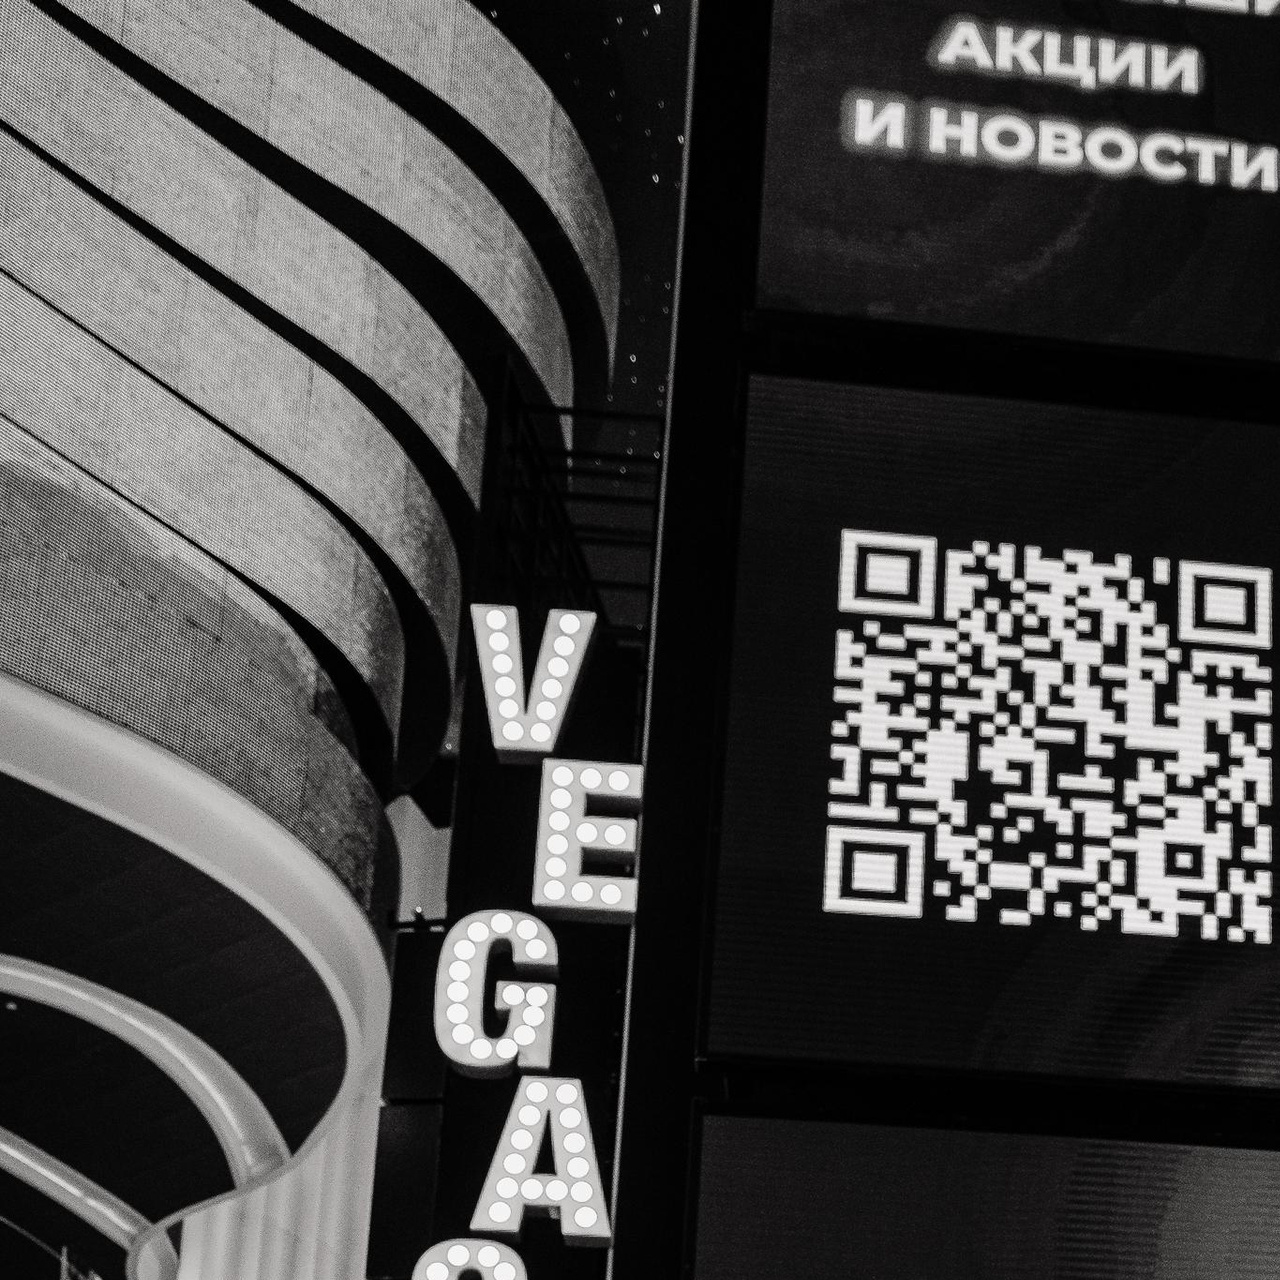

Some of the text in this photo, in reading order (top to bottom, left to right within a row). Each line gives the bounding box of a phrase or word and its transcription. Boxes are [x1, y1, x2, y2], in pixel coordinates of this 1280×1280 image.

[938, 21, 1201, 95] АКЦИИ
[853, 98, 1280, 192] И НОВОСТИ
